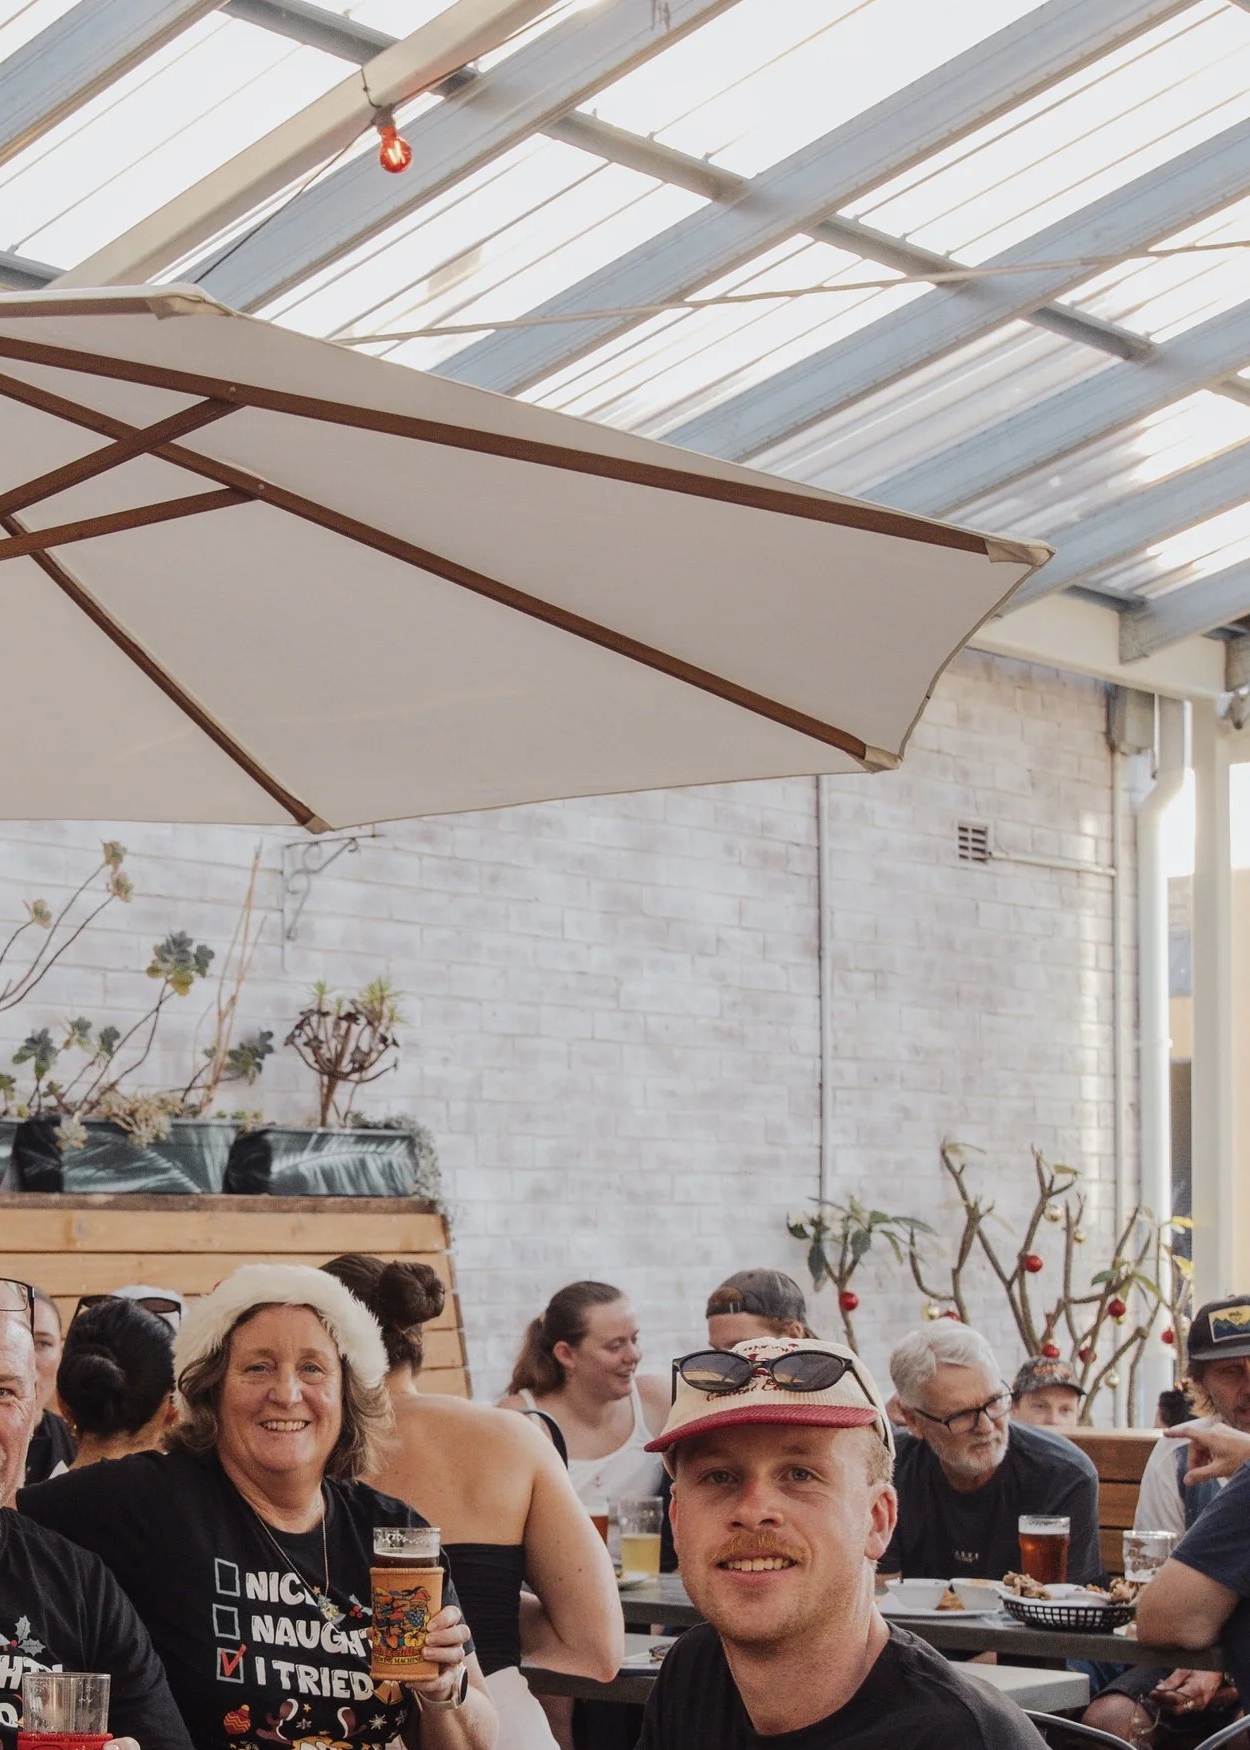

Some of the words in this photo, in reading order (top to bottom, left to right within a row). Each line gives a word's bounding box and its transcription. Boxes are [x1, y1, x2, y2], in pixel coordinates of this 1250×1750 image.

[251, 1614, 373, 1657] NAUGH
[255, 1656, 266, 1686] I
[271, 1659, 374, 1701] TRIED
